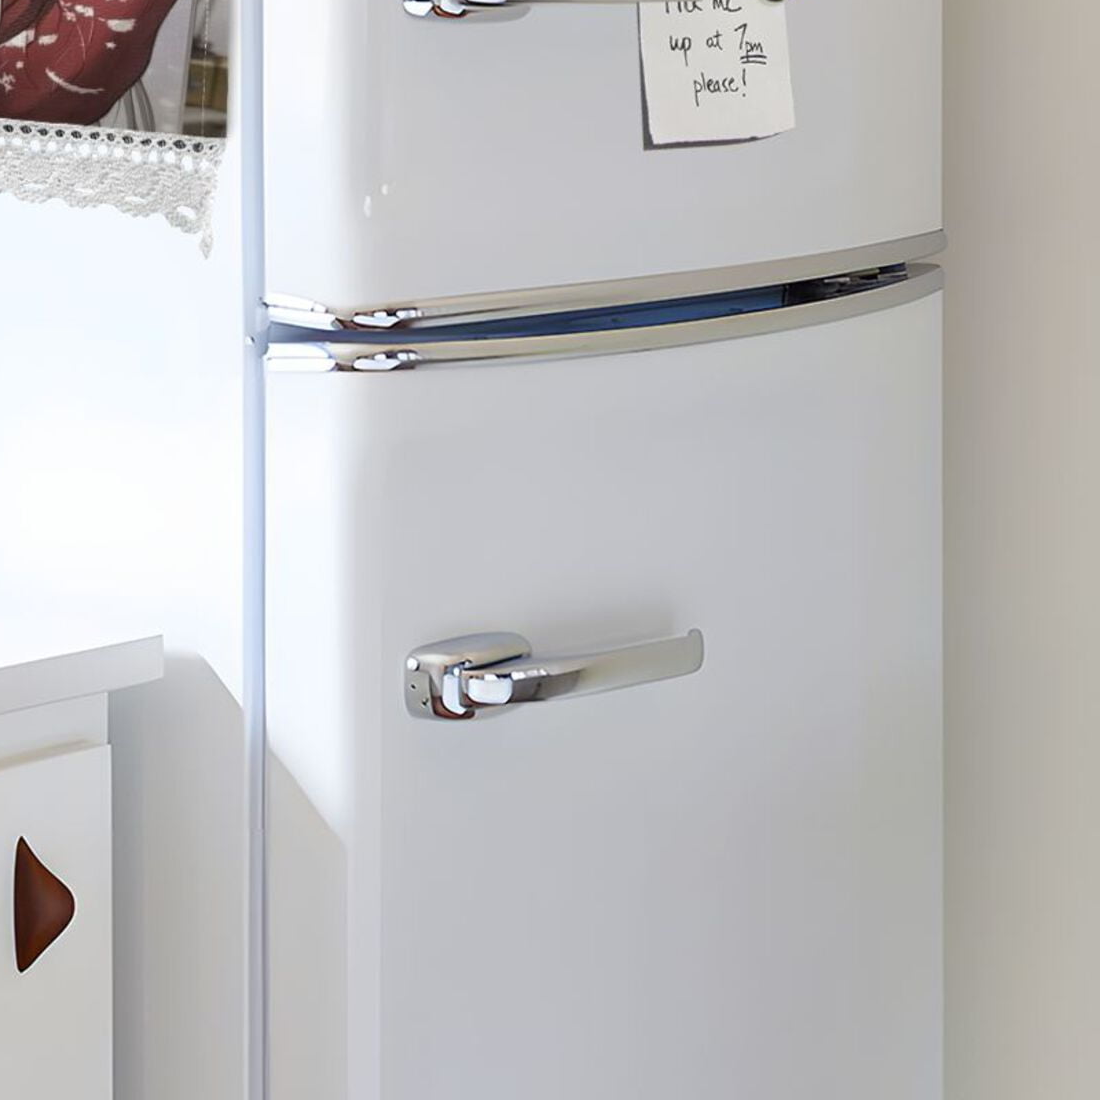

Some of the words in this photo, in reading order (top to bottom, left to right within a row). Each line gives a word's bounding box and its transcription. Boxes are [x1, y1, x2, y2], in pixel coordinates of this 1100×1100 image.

[669, 35, 692, 67] up
[705, 29, 723, 51] at
[693, 68, 747, 107] please!
